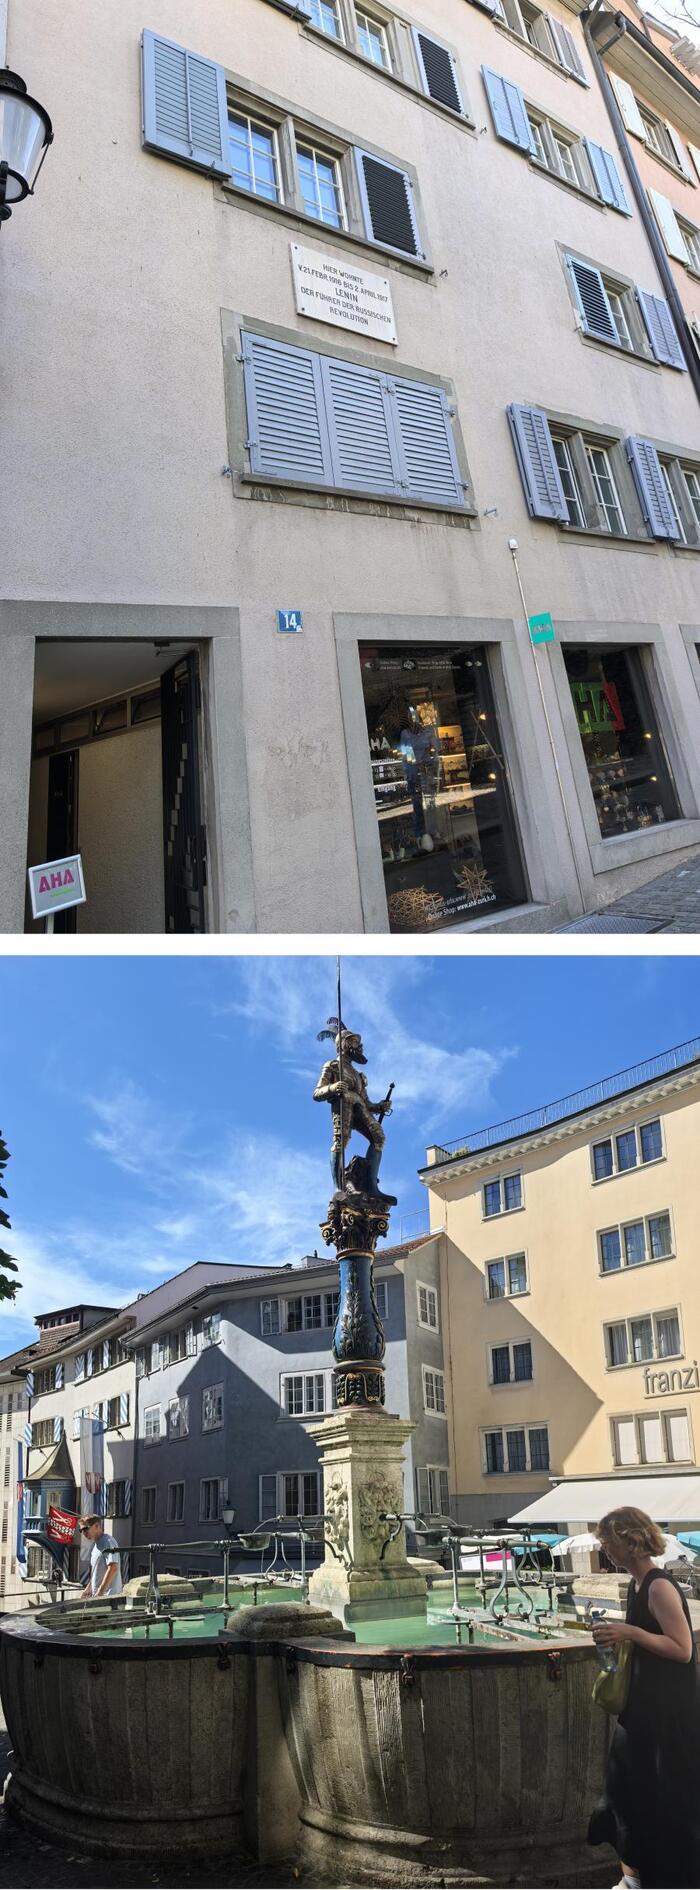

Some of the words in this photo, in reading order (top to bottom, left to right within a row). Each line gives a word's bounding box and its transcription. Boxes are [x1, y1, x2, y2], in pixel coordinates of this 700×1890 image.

[322, 264, 338, 275] HIER
[338, 269, 364, 285] WOHNTE
[335, 288, 358, 302] LENIN
[343, 281, 354, 290] BIS
[300, 286, 315, 298] DER
[342, 301, 355, 311] DER
[355, 306, 391, 323] RUSSISCHEN
[330, 306, 369, 325] REVOLUTION
[284, 613, 297, 629] 14
[39, 868, 74, 893] AHA
[643, 1360, 700, 1394] franzi
